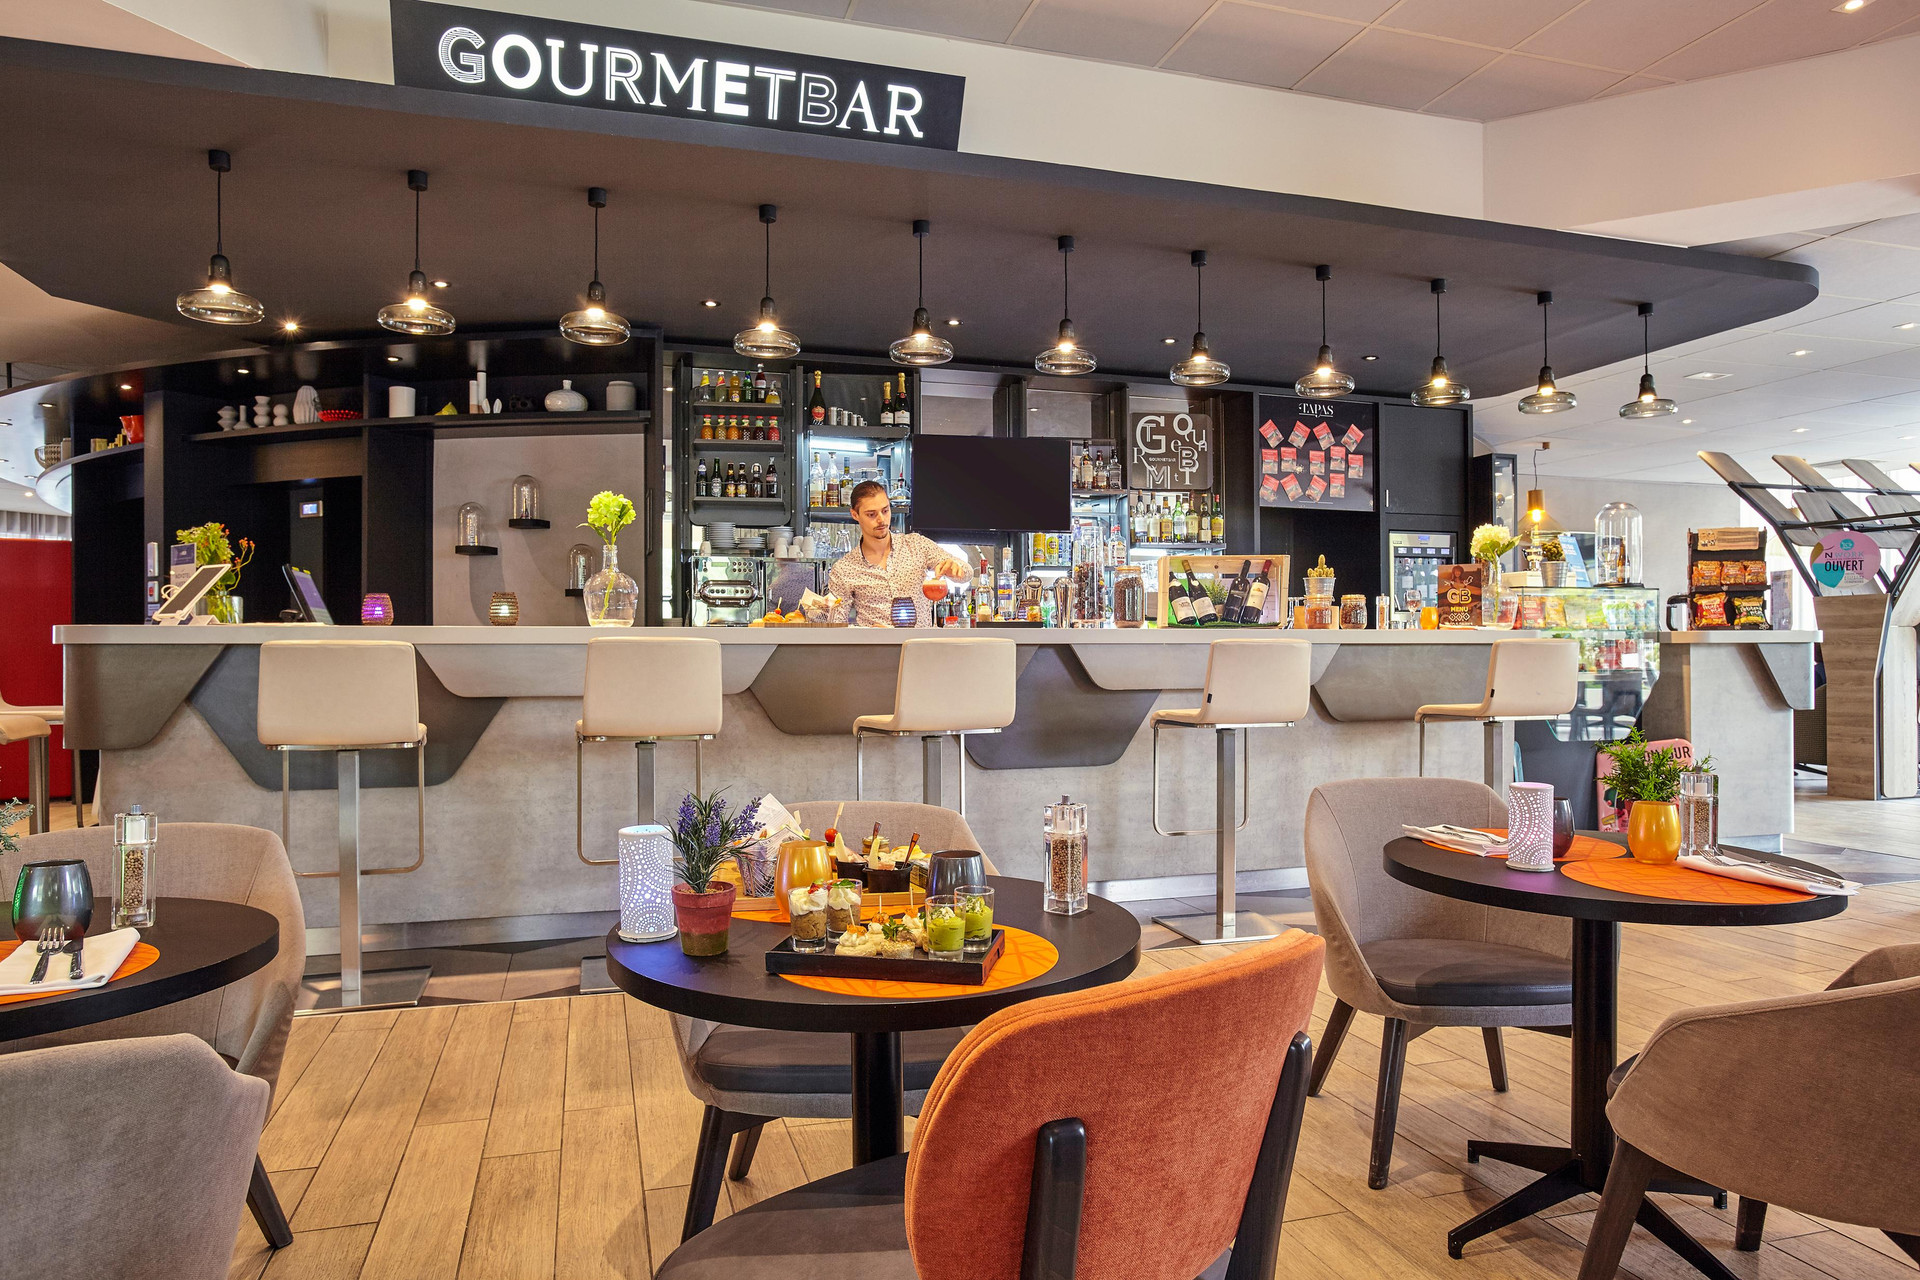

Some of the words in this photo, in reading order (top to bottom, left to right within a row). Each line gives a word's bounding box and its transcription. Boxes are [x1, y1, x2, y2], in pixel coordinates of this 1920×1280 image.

[438, 26, 924, 139] GOURMETBAR
[1299, 403, 1334, 417] TAPAS
[1824, 560, 1865, 572] OUVERT
[1446, 587, 1472, 605] GB
